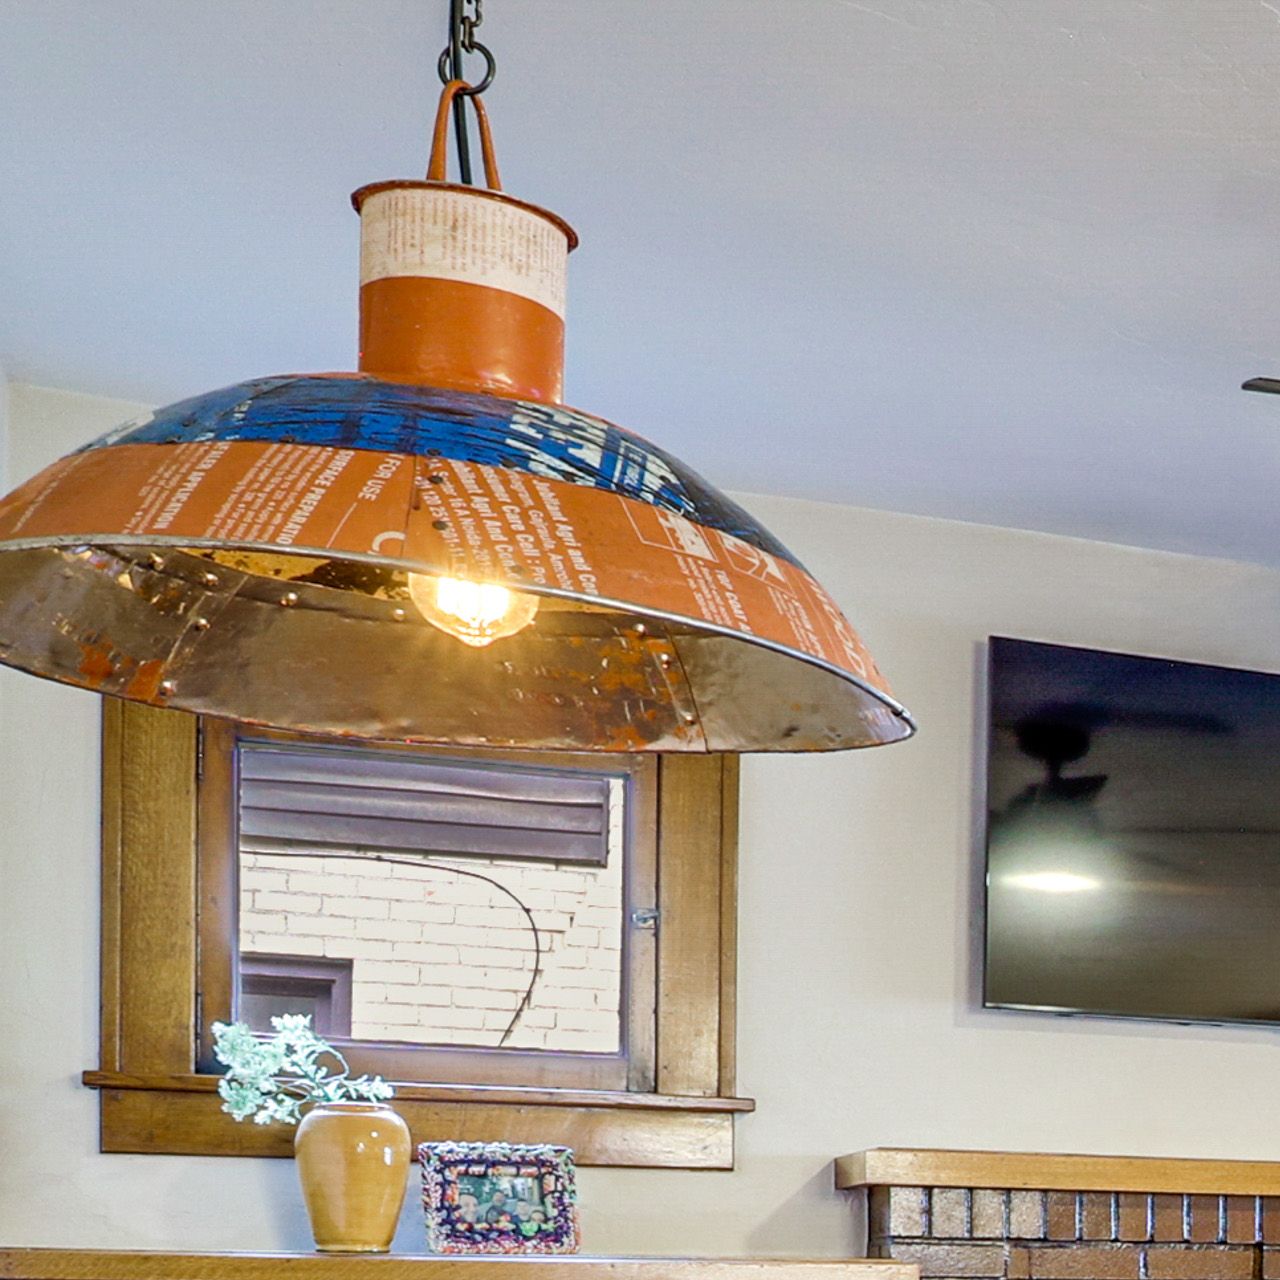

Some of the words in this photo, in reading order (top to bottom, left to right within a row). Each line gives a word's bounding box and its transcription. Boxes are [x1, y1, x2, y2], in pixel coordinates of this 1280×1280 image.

[358, 479, 385, 501] USE
[483, 519, 508, 541] And
[502, 505, 525, 531] Care
[515, 534, 541, 557] Cell
[555, 523, 582, 547] Agri
